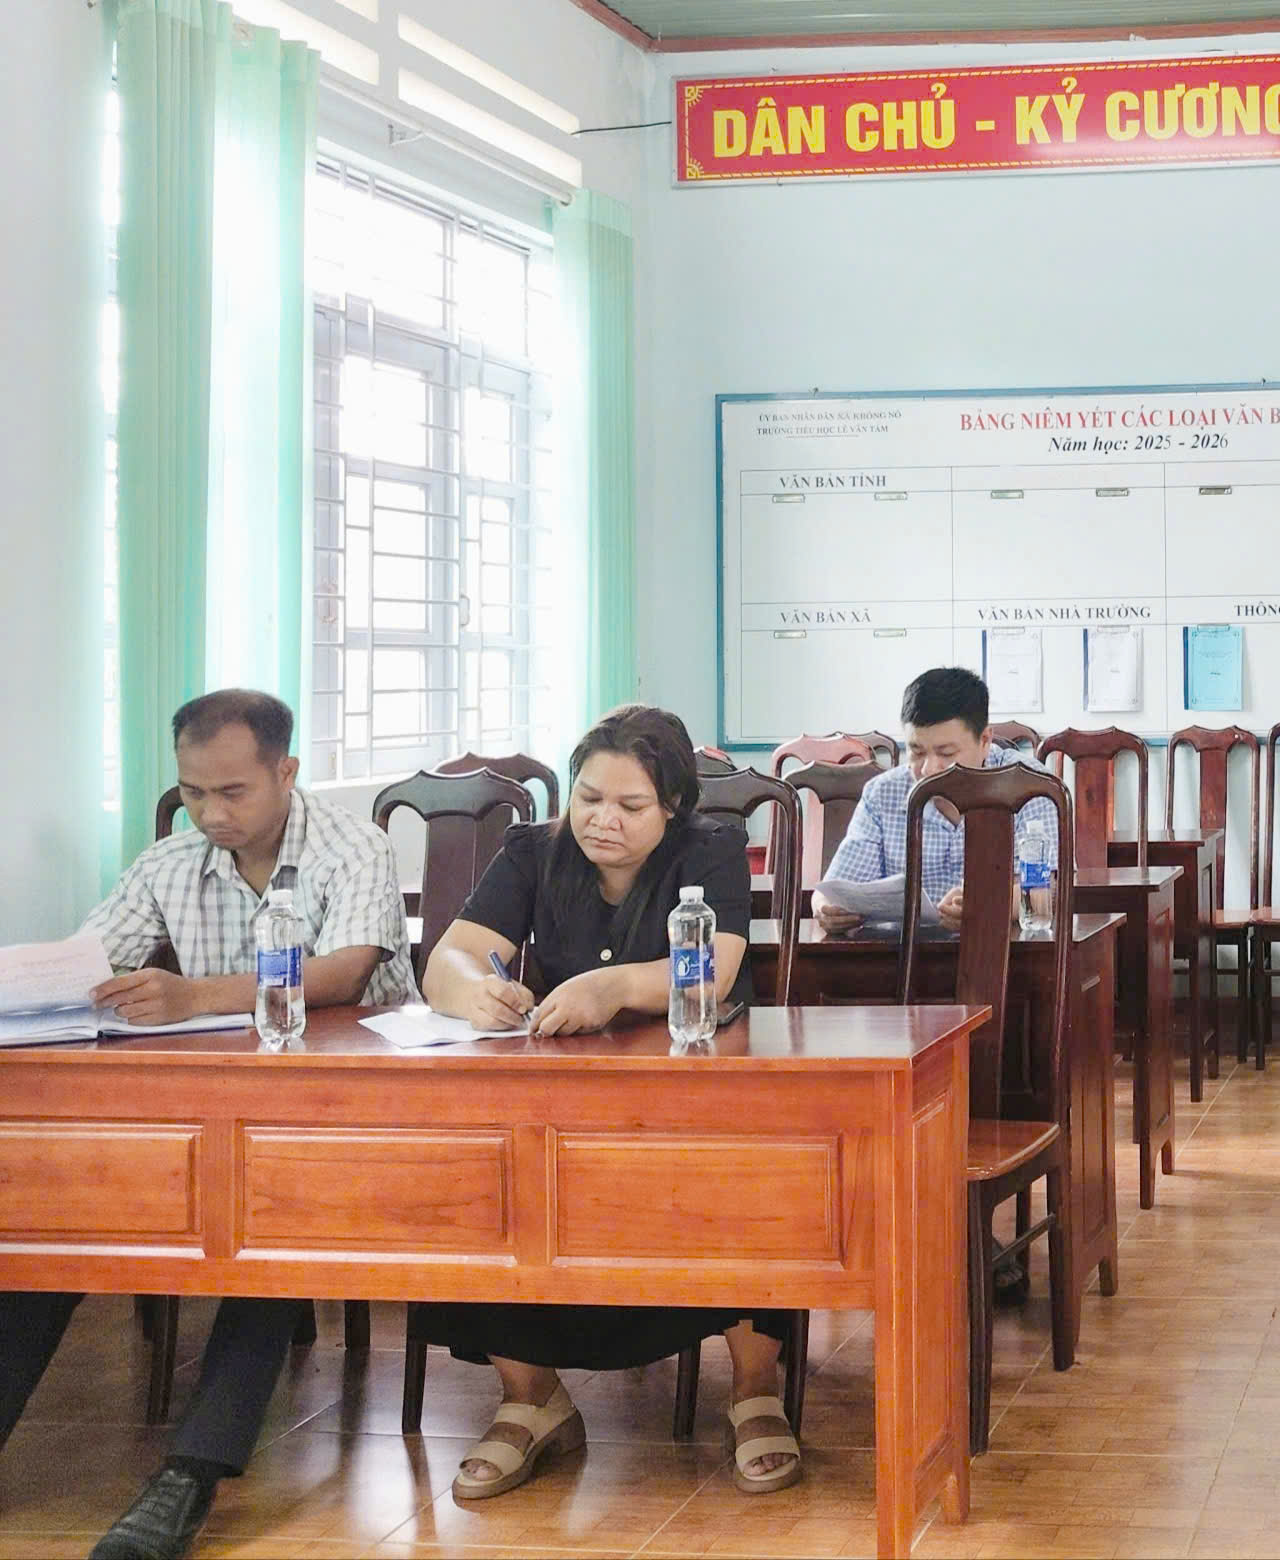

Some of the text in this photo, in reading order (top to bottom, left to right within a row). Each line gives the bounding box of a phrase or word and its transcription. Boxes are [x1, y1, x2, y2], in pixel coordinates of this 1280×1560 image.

[712, 98, 825, 159] DÂN
[845, 83, 955, 150] CHỦ
[1015, 77, 1081, 145] KỶ
[960, 408, 1015, 431] BẢNG
[1021, 405, 1072, 430] NIÊM
[1078, 404, 1116, 429] YẾT
[1121, 403, 1163, 428] CÁC
[1169, 408, 1217, 430] LOẠI
[1224, 402, 1263, 426] VĂN
[1048, 435, 1089, 452] Năm
[1093, 434, 1128, 454] học:
[1134, 435, 1172, 451] 2025
[1191, 433, 1228, 450] 2026
[779, 475, 811, 489] VĂN
[815, 472, 847, 488] BẢN
[779, 608, 872, 624] VĂN BẢN XÃ
[978, 603, 1152, 621] VĂN BẢN NHÀ TRƯỜNG
